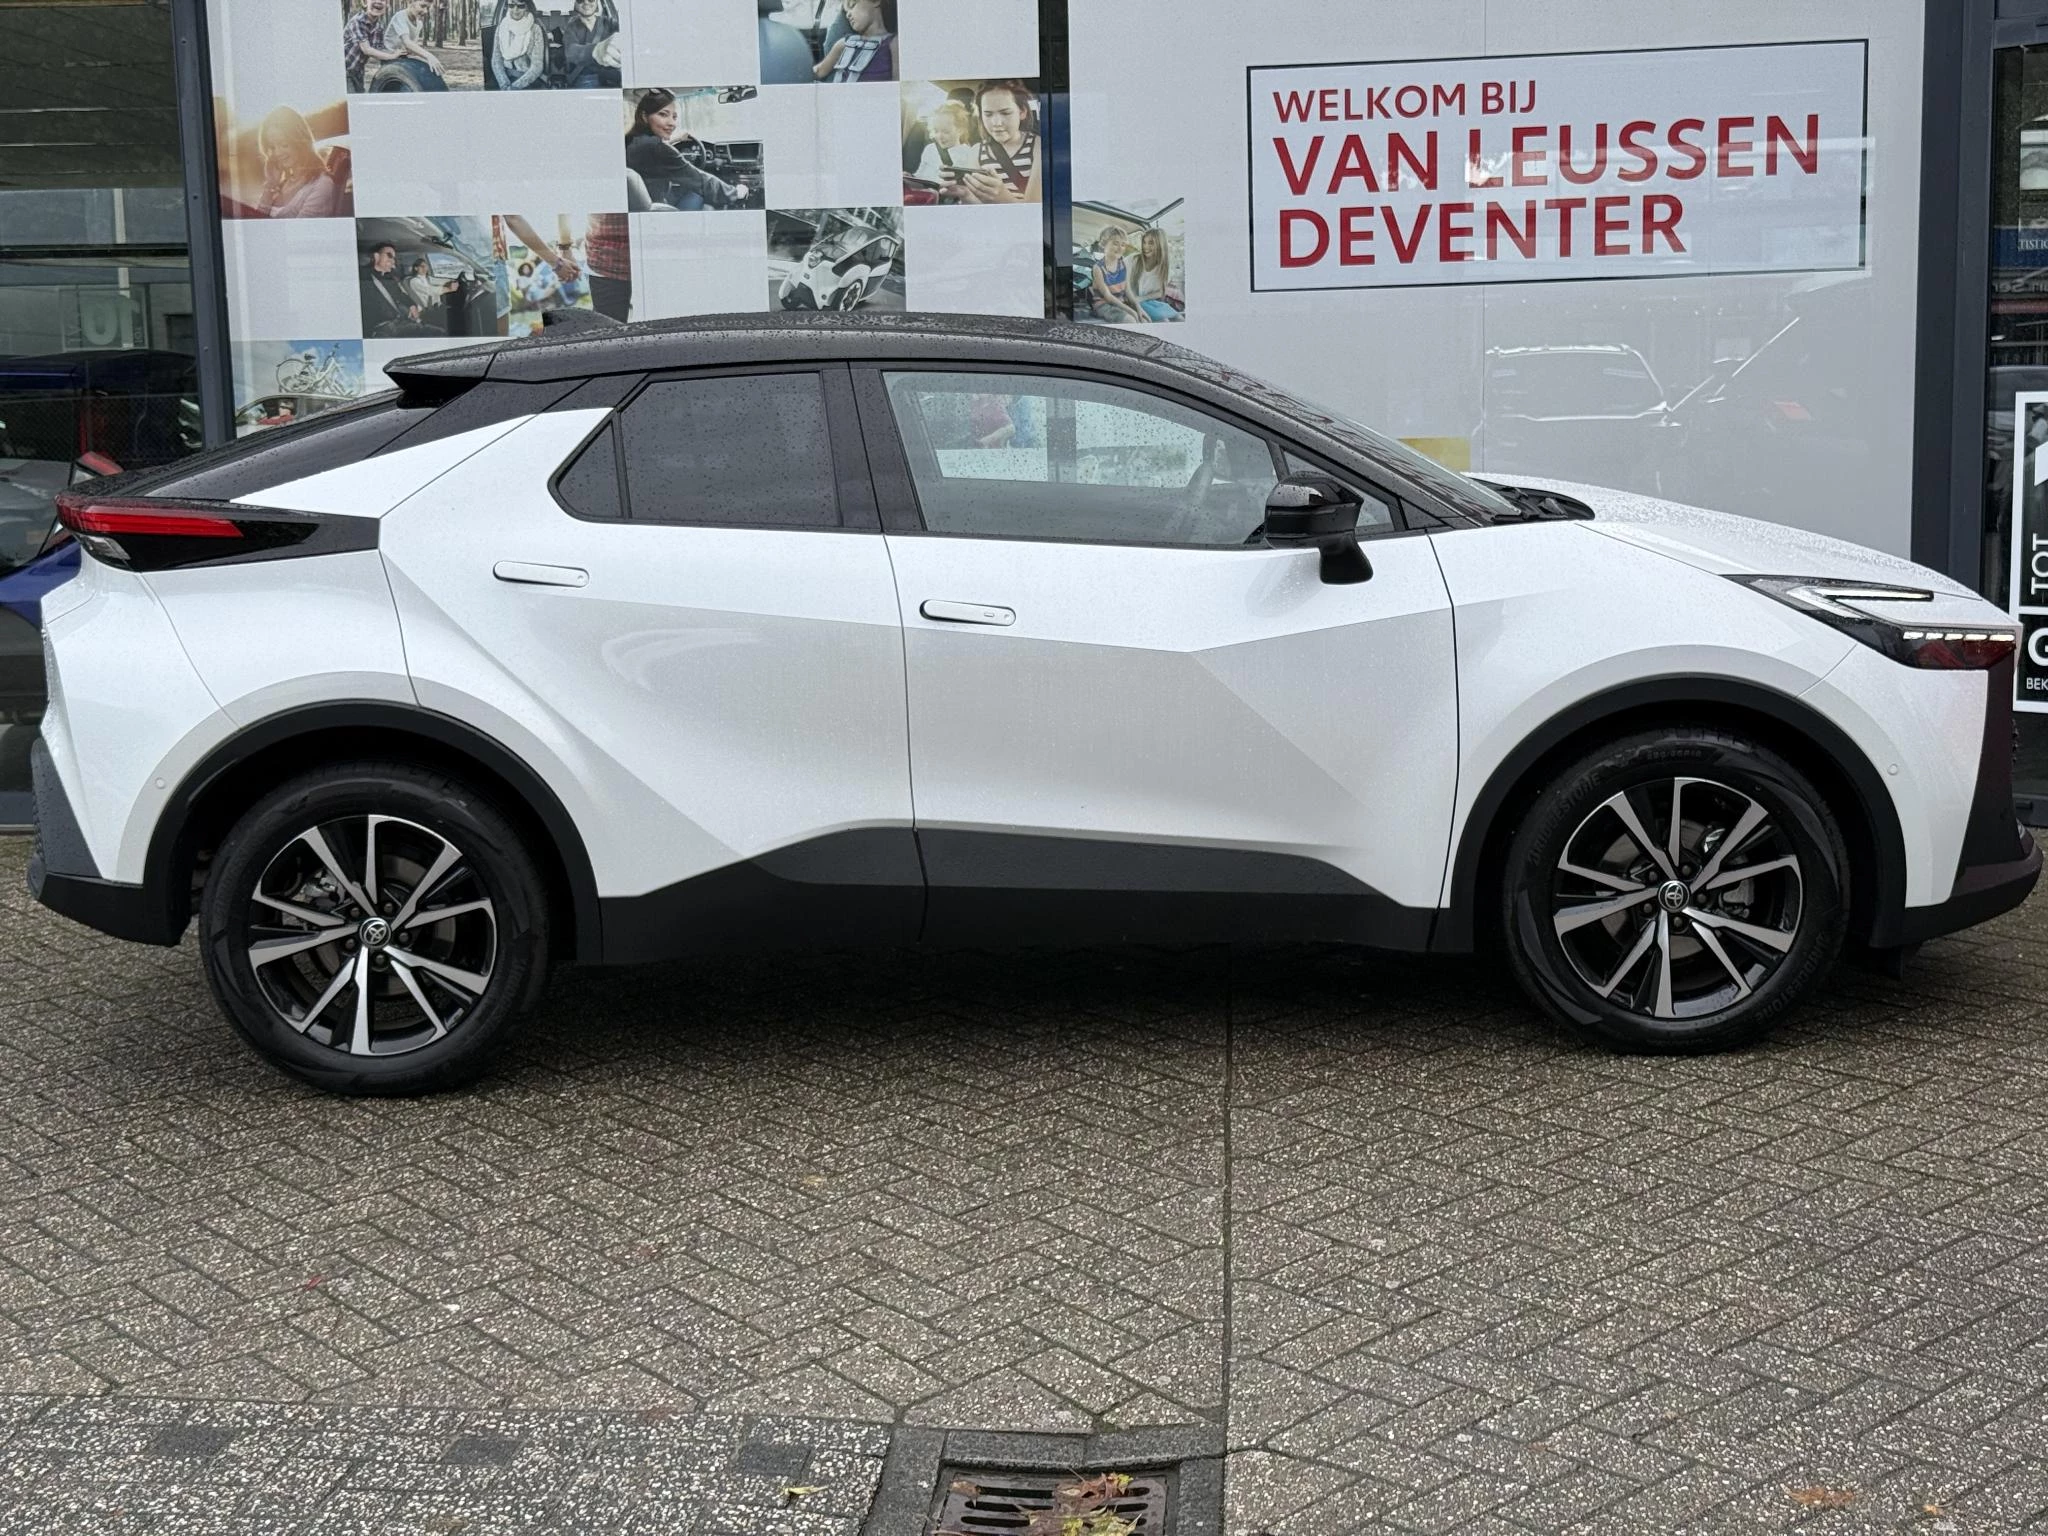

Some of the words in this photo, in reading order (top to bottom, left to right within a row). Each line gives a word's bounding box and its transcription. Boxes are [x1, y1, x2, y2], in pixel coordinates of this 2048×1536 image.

[1273, 82, 1466, 122] WELKOM
[1481, 80, 1537, 114] BIJ
[1272, 130, 1439, 196] VAN
[1468, 113, 1820, 189] LEUSSEN
[1279, 193, 1686, 269] DEVENTER
